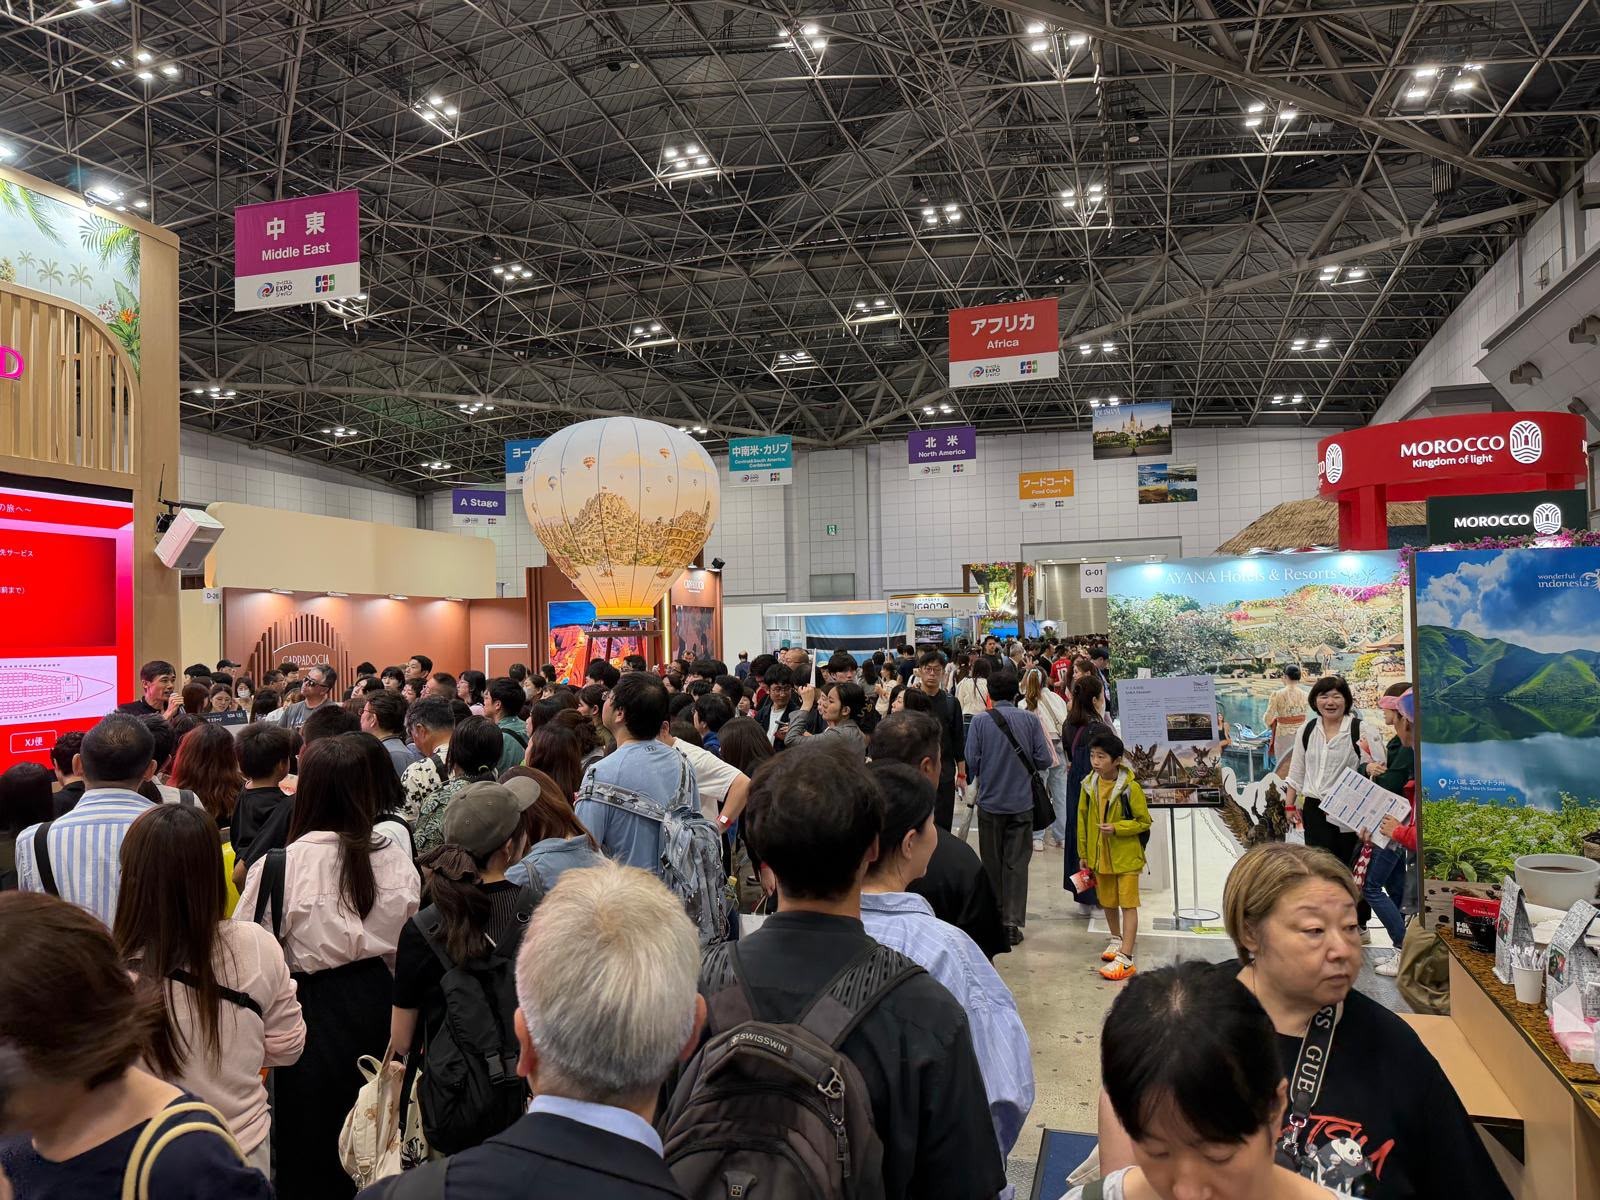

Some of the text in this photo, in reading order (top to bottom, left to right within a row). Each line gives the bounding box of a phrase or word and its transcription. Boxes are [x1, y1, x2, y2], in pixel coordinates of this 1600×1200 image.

[261, 242, 331, 261] Middle East
[275, 284, 293, 292] EXPO
[970, 313, 1035, 336] アフリカ
[986, 339, 1020, 350] Africa
[732, 442, 789, 457] 中南米・カリブ
[938, 449, 967, 457] America
[1400, 435, 1505, 458] MOROCCO
[1412, 453, 1493, 469] Kingdom of light
[1022, 475, 1071, 489] フードコート
[460, 498, 499, 508] A Stage
[1454, 513, 1530, 528] MOROCCO
[1085, 568, 1104, 577] G-01
[1165, 571, 1217, 585] AYANA
[1268, 568, 1281, 582] &
[1283, 567, 1337, 581] Resorts
[1537, 572, 1576, 580] wonderful
[1085, 585, 1104, 594] G-02
[1537, 579, 1590, 588] indonesia
[281, 653, 330, 666] CAPPADOCIA
[24, 736, 43, 747] XJ便
[739, 1032, 788, 1053] SWISSWIN
